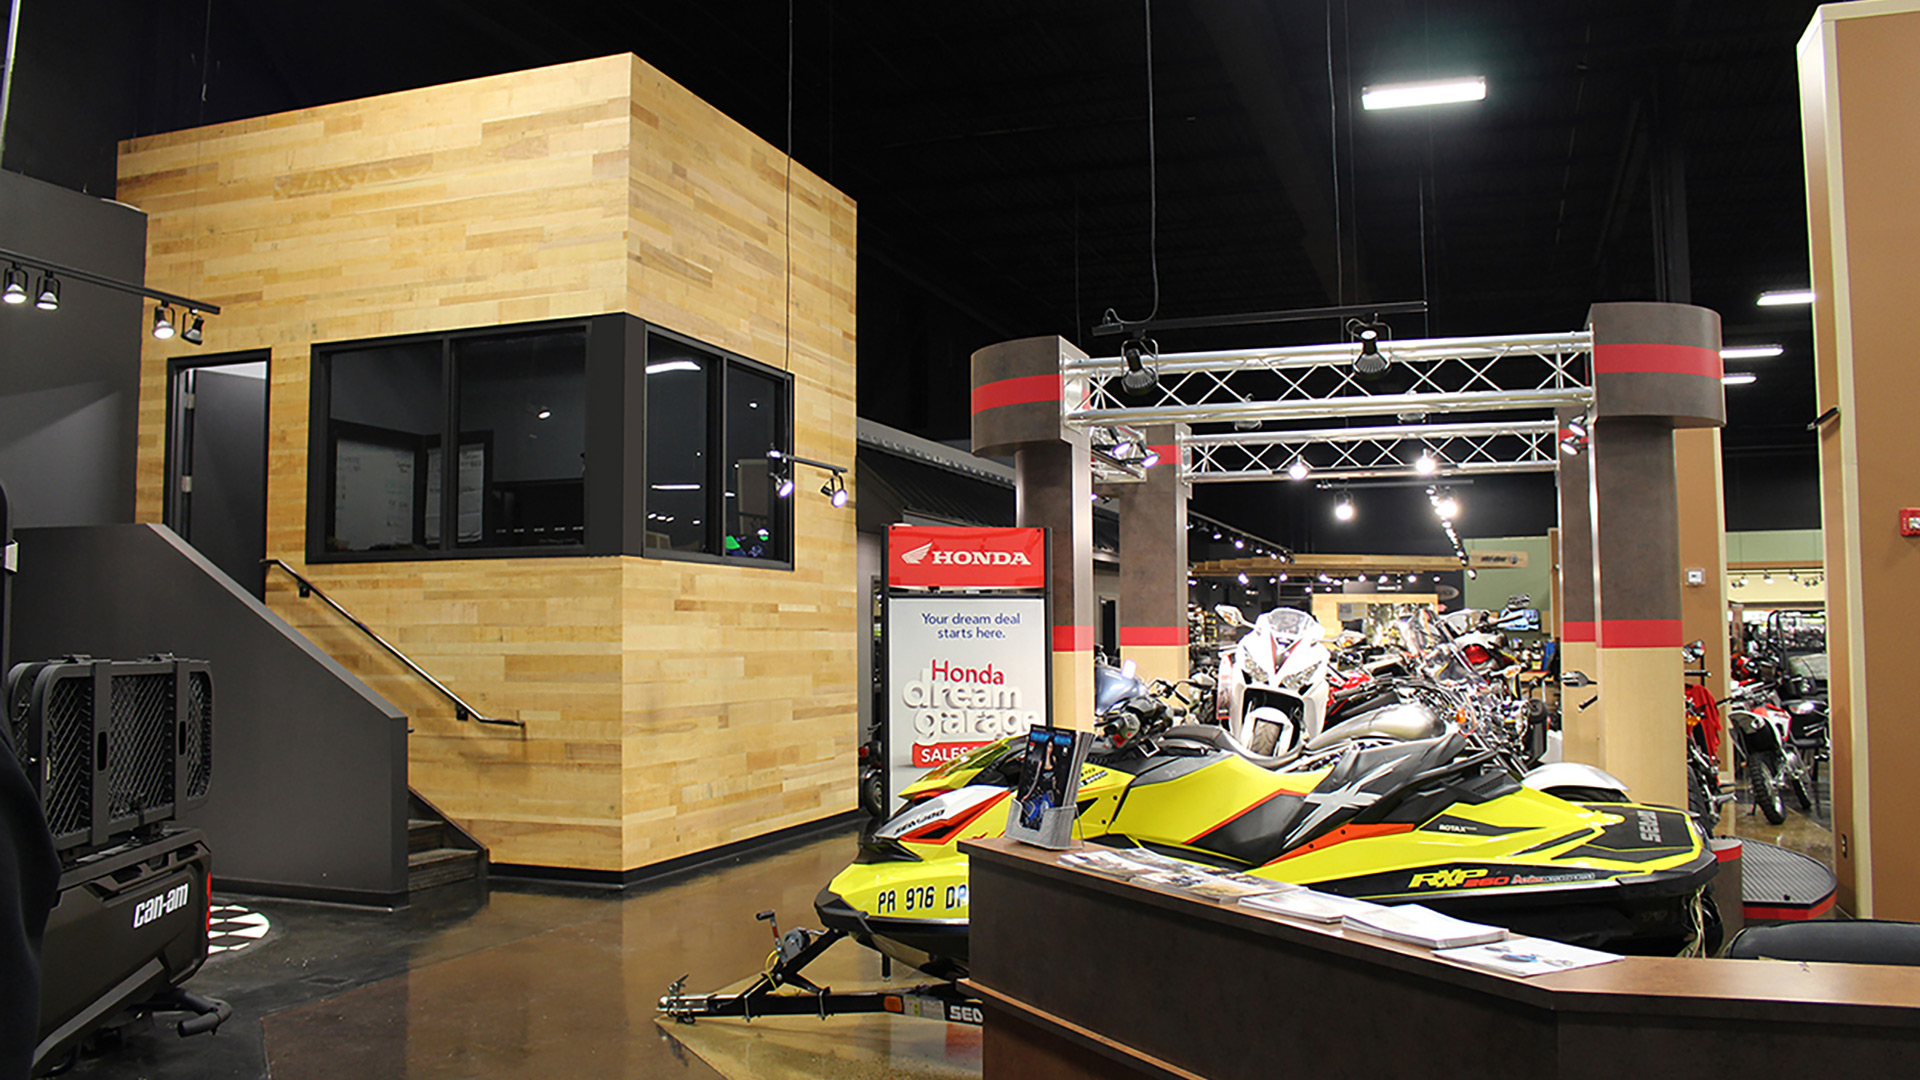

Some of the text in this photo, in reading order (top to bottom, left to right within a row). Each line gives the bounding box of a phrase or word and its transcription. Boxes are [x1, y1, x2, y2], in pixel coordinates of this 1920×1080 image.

[931, 551, 1031, 565] HONDA
[921, 613, 1021, 625] Your dream deal
[937, 627, 1006, 639] starts here.
[931, 658, 1005, 685] Honda
[902, 668, 1021, 709] dream
[913, 709, 1040, 745] garage
[1408, 869, 1489, 888] RXP
[132, 883, 189, 928] can-am
[877, 890, 896, 914] PA
[905, 886, 935, 911] 976
